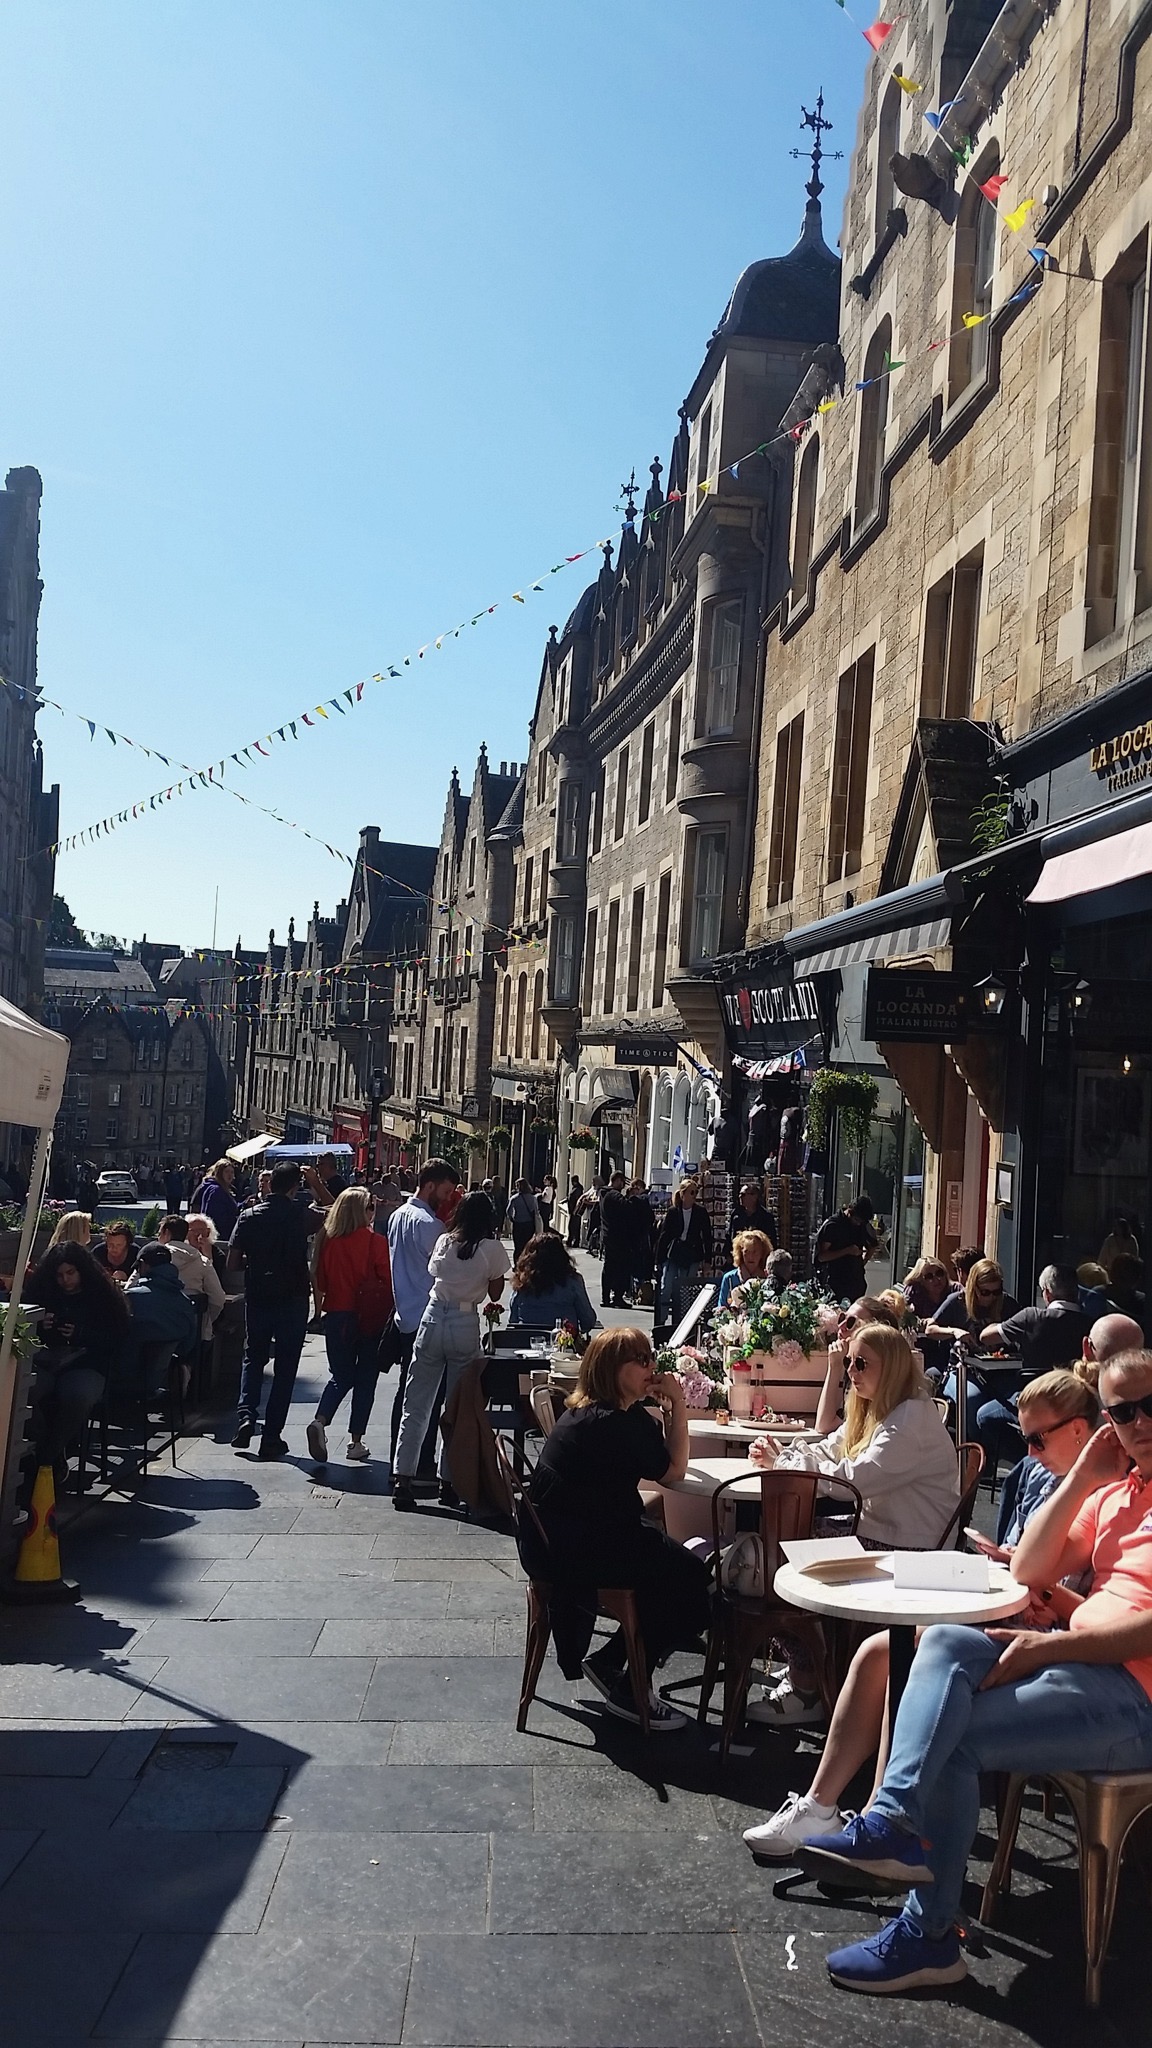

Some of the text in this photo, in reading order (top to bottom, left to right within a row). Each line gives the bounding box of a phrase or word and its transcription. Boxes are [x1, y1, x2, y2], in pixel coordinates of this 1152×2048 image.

[1090, 742, 1107, 772] LA
[1107, 763, 1147, 791] ITALIAN
[905, 986, 926, 998] LA
[751, 981, 819, 1025] SCOTLAND
[876, 1001, 958, 1015] LOCANDA
[876, 1017, 957, 1028] ITALIAN BISTRO
